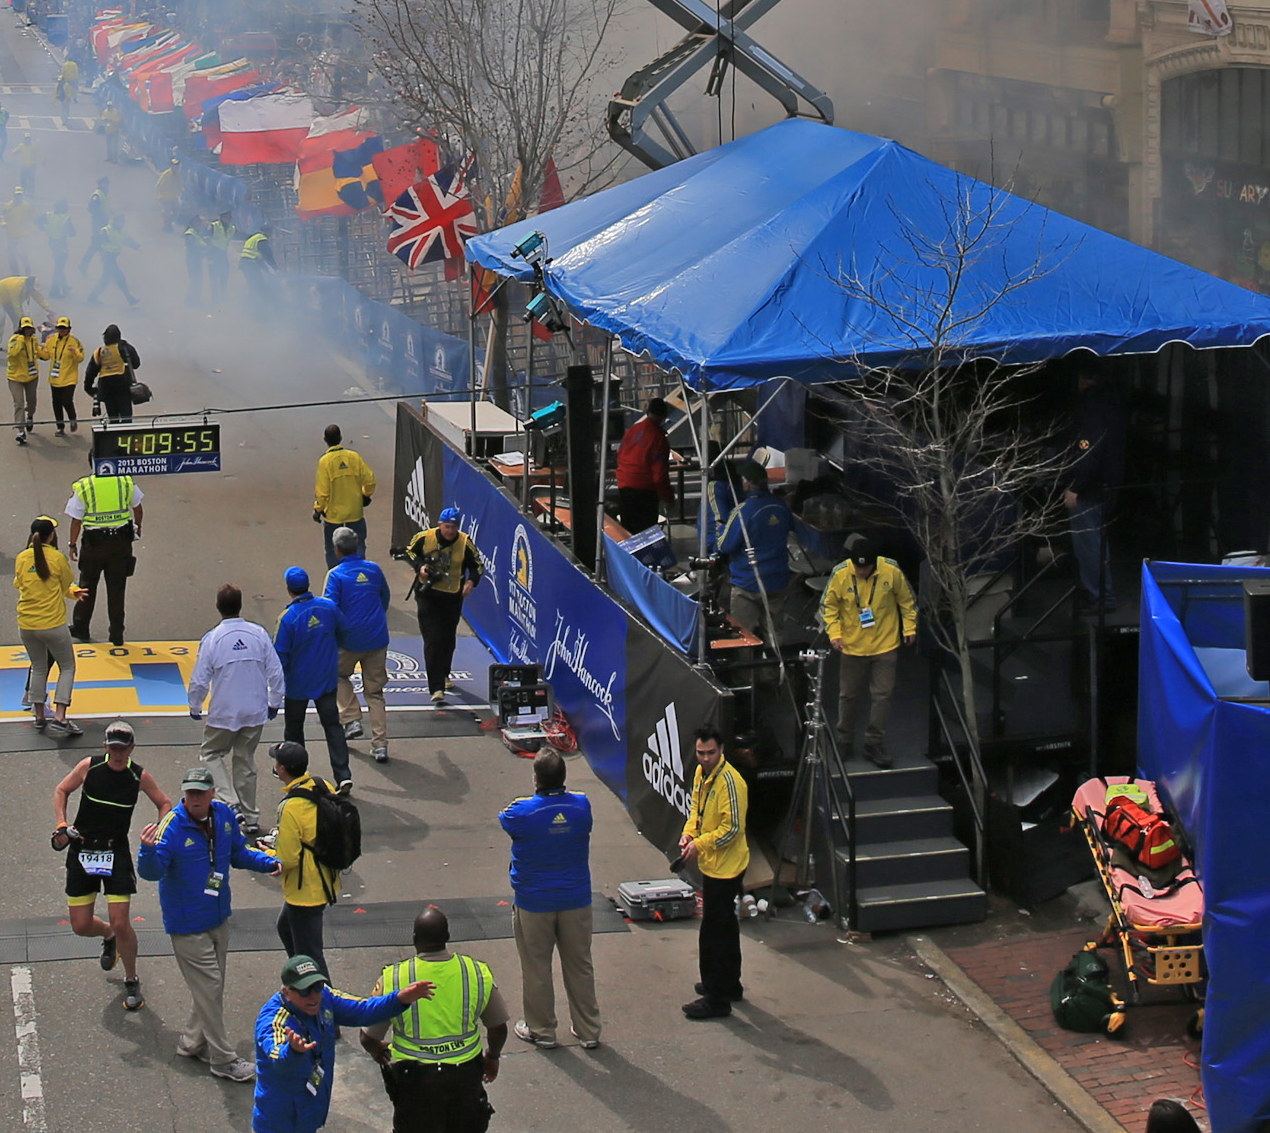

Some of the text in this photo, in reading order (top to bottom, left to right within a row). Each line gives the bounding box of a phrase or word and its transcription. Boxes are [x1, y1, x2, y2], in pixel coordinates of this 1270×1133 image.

[117, 430, 213, 455] 4:09:55
[117, 457, 167, 467] 2013 BOSTON
[117, 464, 168, 475] MARATHON
[76, 646, 189, 657] 2013
[544, 608, 621, 741] John Hancock
[81, 854, 112, 863] 19418
